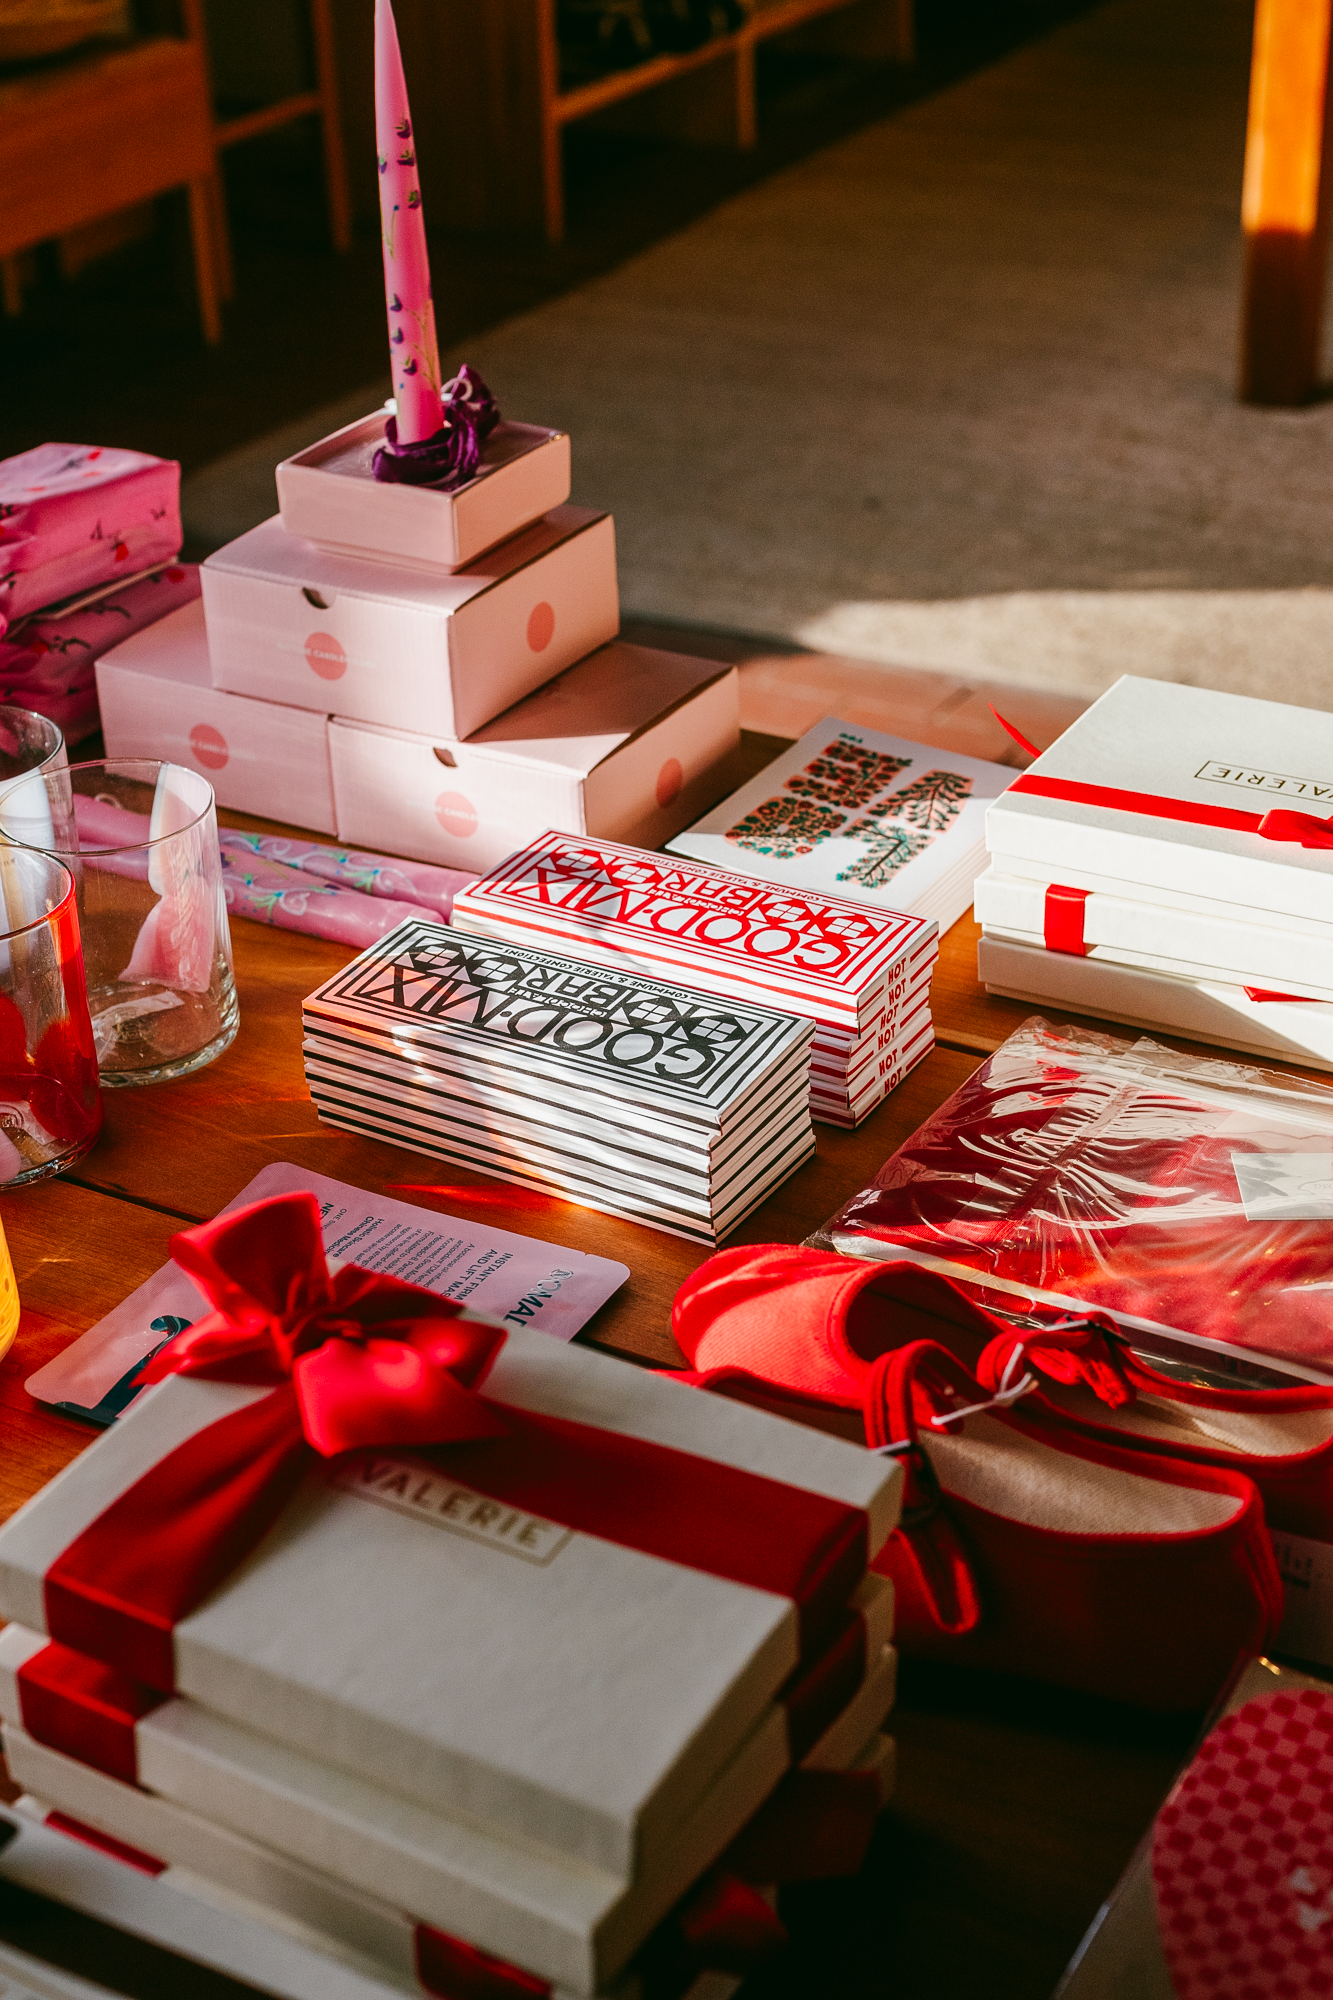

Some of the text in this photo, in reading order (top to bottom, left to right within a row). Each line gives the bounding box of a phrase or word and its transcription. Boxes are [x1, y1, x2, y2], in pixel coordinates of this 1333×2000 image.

[1212, 767, 1333, 799] ALERIE
[640, 855, 706, 875] CONFECTIONS
[708, 870, 748, 885] VALERIE
[649, 888, 745, 916] CHOCOLATE
[665, 872, 755, 908] BAR
[763, 884, 819, 902] COMMUNE
[502, 947, 689, 999] COMMUNE & VALERIE CONFECTIONS
[888, 957, 907, 985] HOT
[526, 967, 627, 1007] BAR
[888, 978, 906, 1006] HOT
[506, 986, 607, 1018] CHOCOLATE
[880, 1003, 899, 1031] HOT
[877, 1023, 896, 1050] HOT
[879, 1048, 898, 1077] HOT
[884, 1067, 902, 1095] HOT
[331, 1218, 385, 1258] Holistic Skincare
[346, 1215, 376, 1237] Chinese
[438, 1248, 498, 1298] AND LIFT MAS
[452, 1252, 513, 1300] INSTANT FIRM
[363, 1460, 549, 1548] VALERIE
